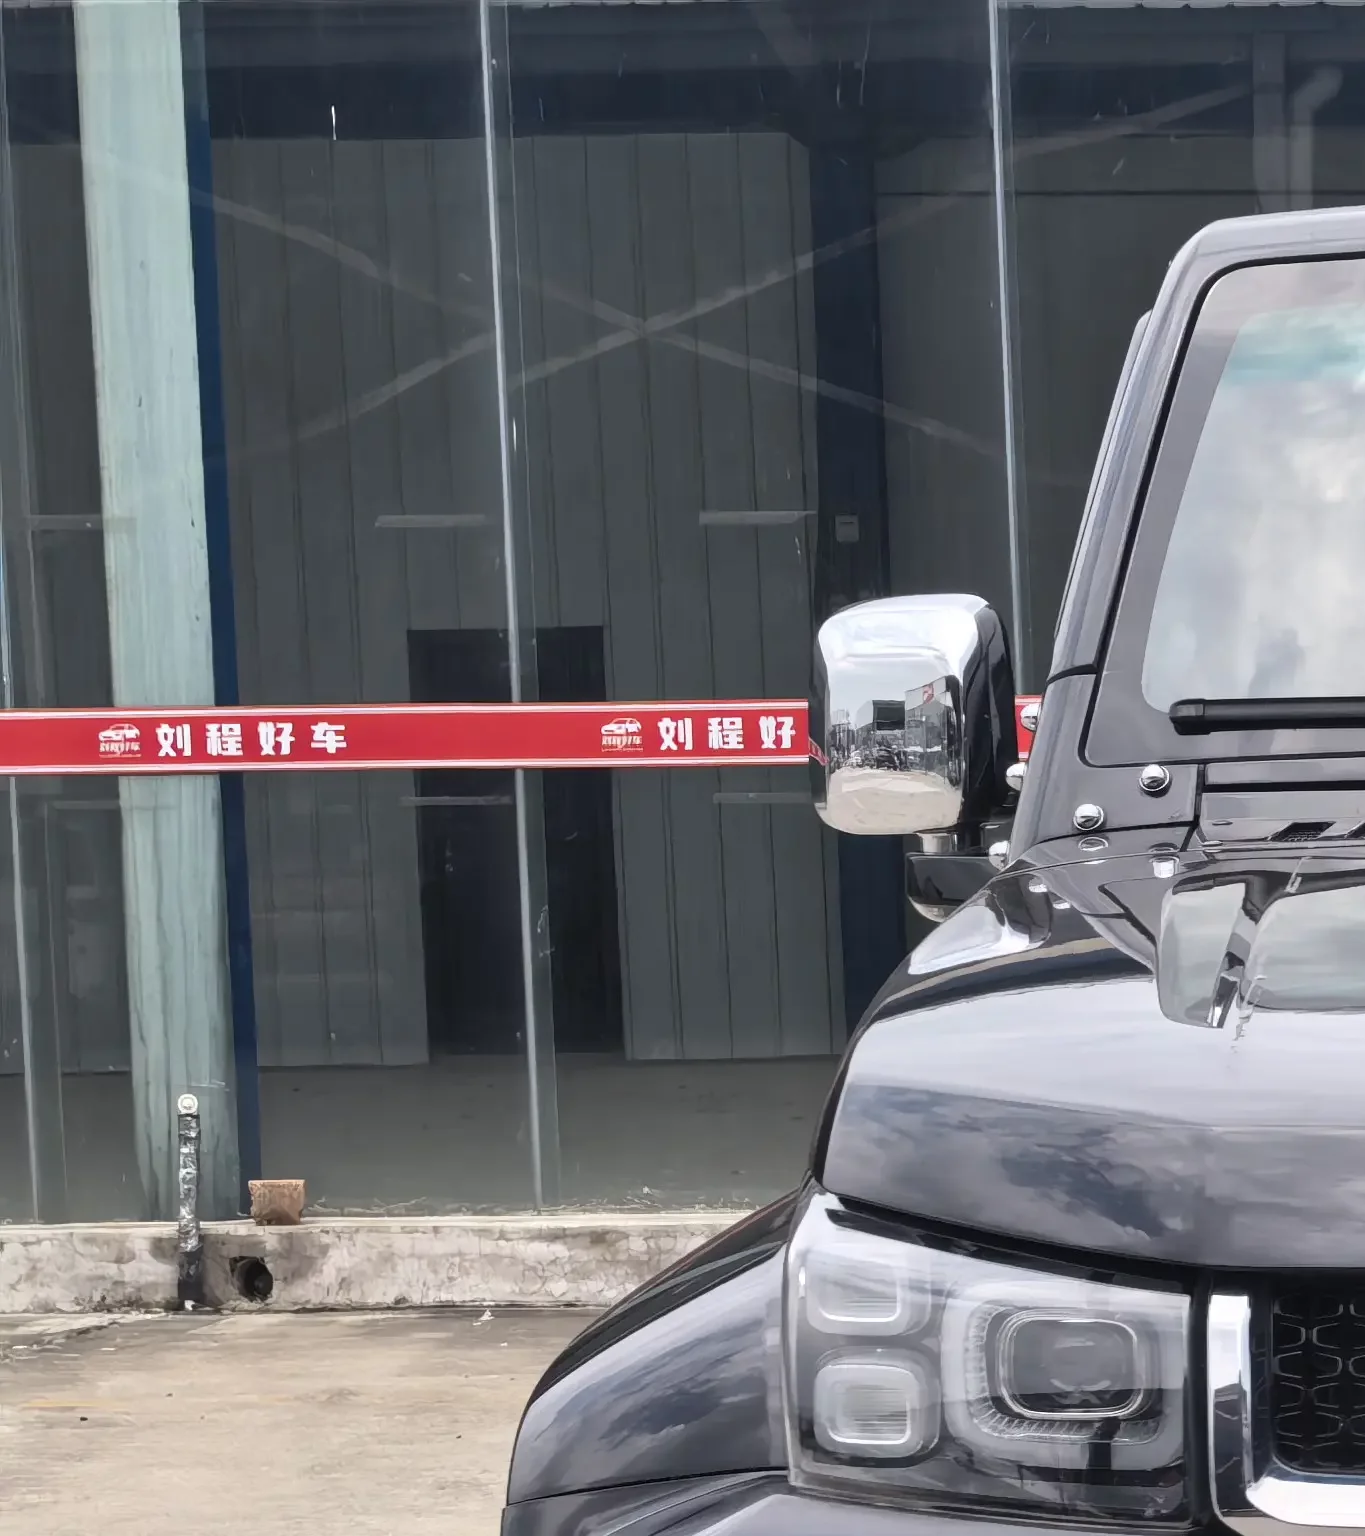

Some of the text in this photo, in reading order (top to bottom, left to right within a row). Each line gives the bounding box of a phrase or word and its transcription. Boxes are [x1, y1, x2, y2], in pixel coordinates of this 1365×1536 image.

[156, 722, 347, 756] 刘程好车
[658, 716, 796, 750] 刘程好
